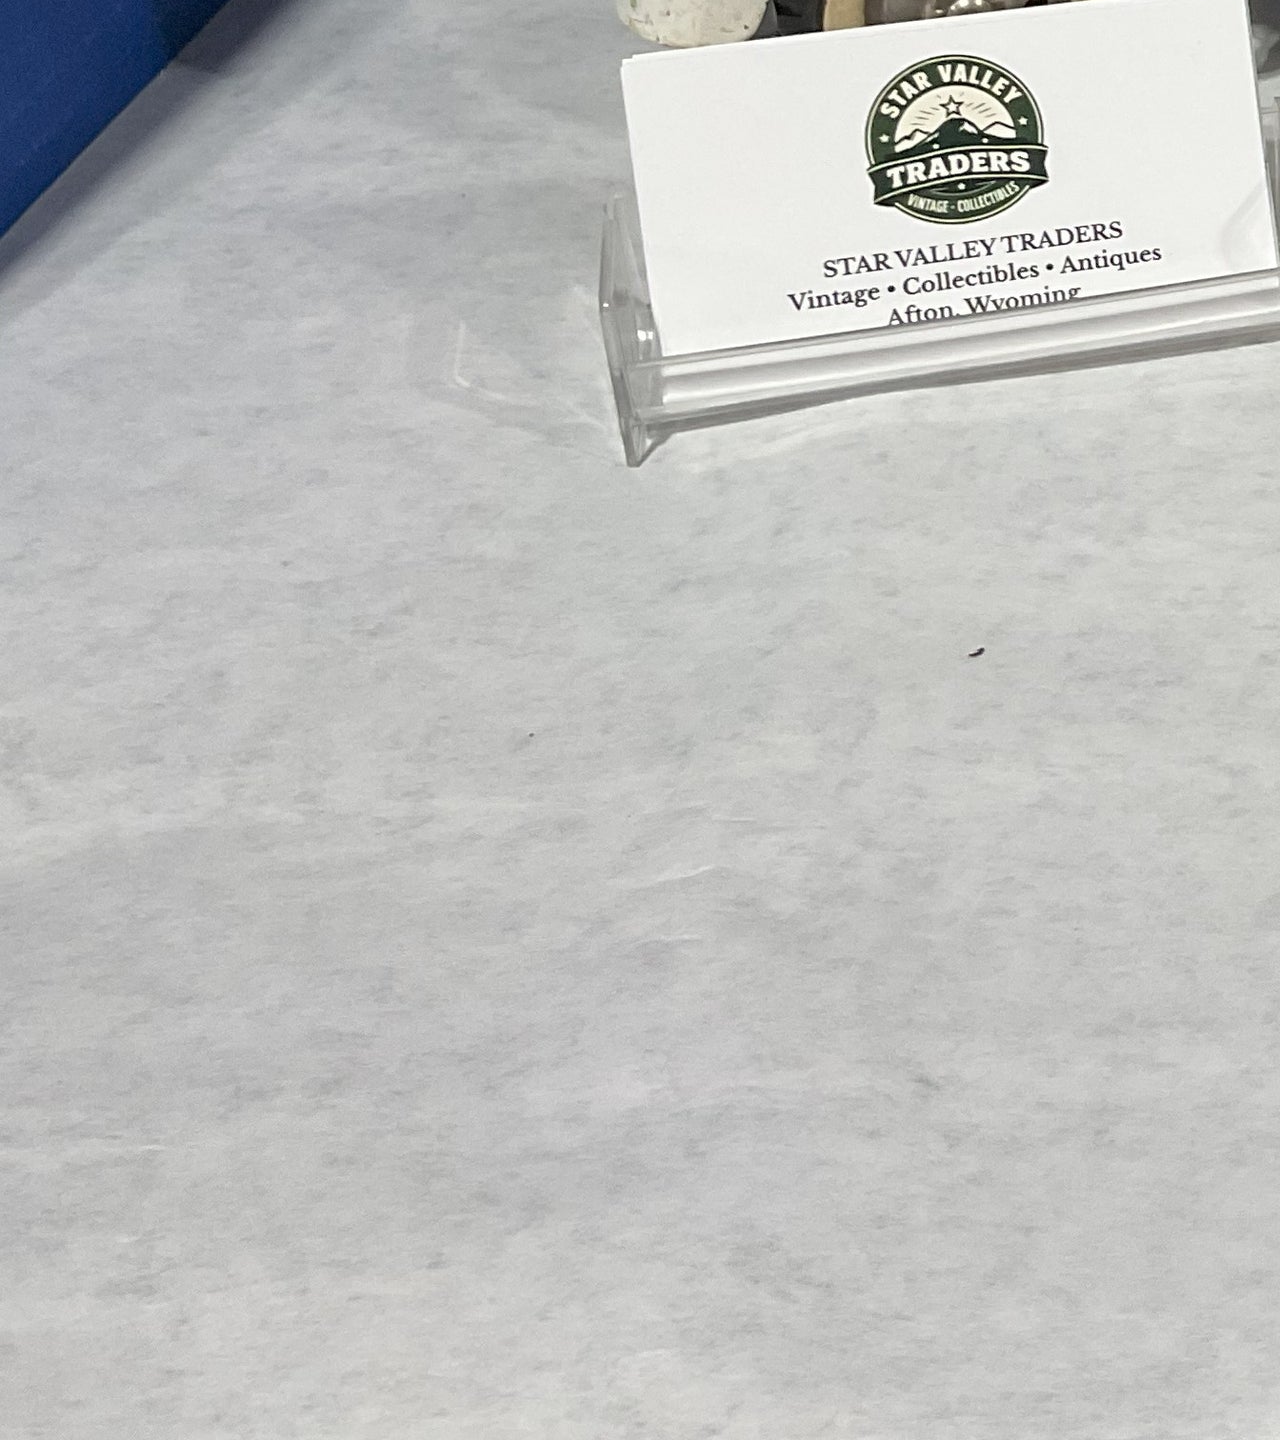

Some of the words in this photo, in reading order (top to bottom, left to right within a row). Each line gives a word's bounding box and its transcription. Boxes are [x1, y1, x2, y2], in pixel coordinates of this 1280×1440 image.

[879, 71, 933, 120] STAR
[936, 62, 1023, 104] VALLEY
[885, 150, 1031, 189] TRADERS
[907, 193, 950, 214] VINTAGE
[957, 180, 1021, 213] COLLECTIBLES
[823, 253, 893, 278] STAR
[894, 237, 999, 268] VALLEY
[1000, 220, 1124, 255] TRADERS
[787, 285, 880, 312] Vintage
[902, 262, 1040, 297] Collectibles
[1060, 246, 1163, 274] Antiques
